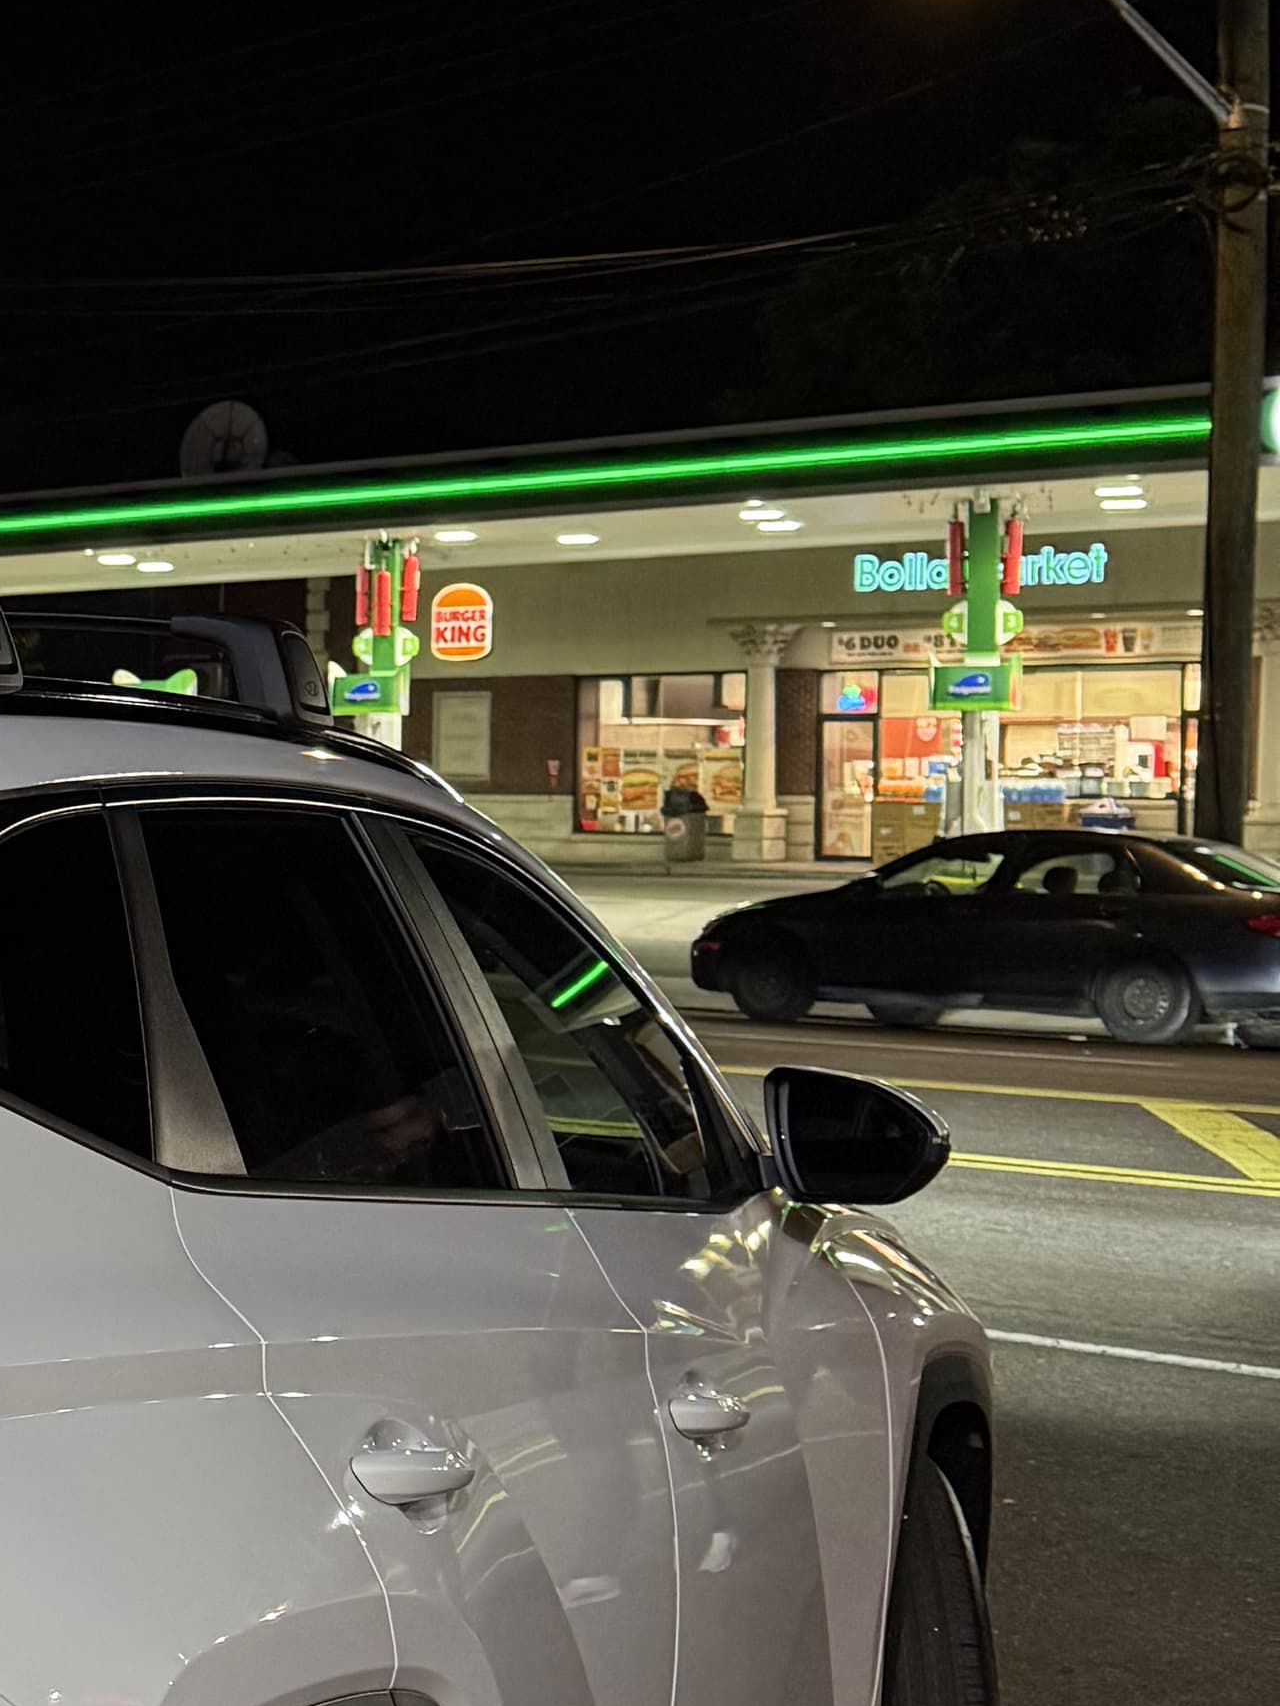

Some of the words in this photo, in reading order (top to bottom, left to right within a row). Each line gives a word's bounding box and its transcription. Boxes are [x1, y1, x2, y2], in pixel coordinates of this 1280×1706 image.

[435, 609, 487, 623] BURGER
[435, 625, 487, 644] KING
[860, 635, 899, 650] DUO
